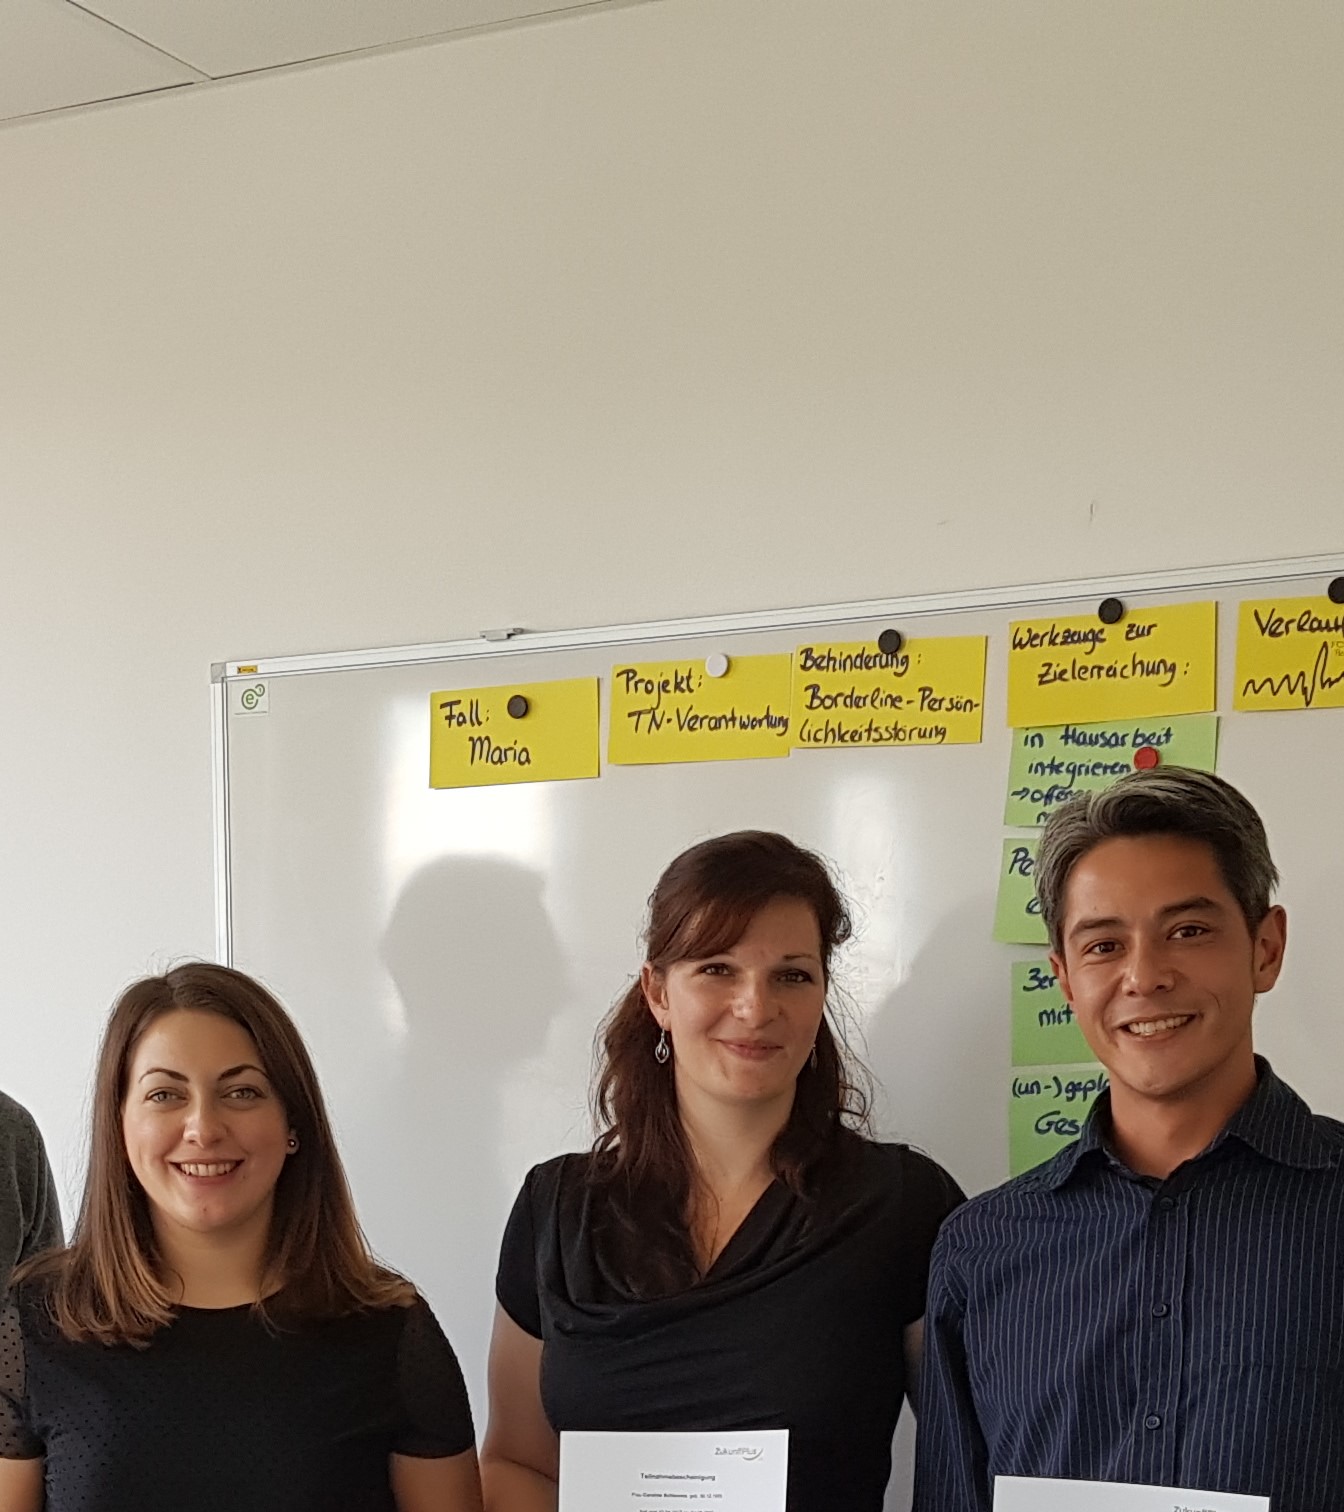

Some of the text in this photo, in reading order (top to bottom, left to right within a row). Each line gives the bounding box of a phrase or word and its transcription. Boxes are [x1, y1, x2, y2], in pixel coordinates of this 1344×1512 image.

[1012, 622, 1158, 655] Werkzeuge zur
[616, 667, 703, 709] Projekt:
[439, 698, 490, 729] Fall:
[627, 704, 791, 737] TN-Verantwortung
[468, 734, 532, 767] Maria
[1023, 725, 1174, 749] in Hausarbeit
[1028, 755, 1132, 789] integrieren
